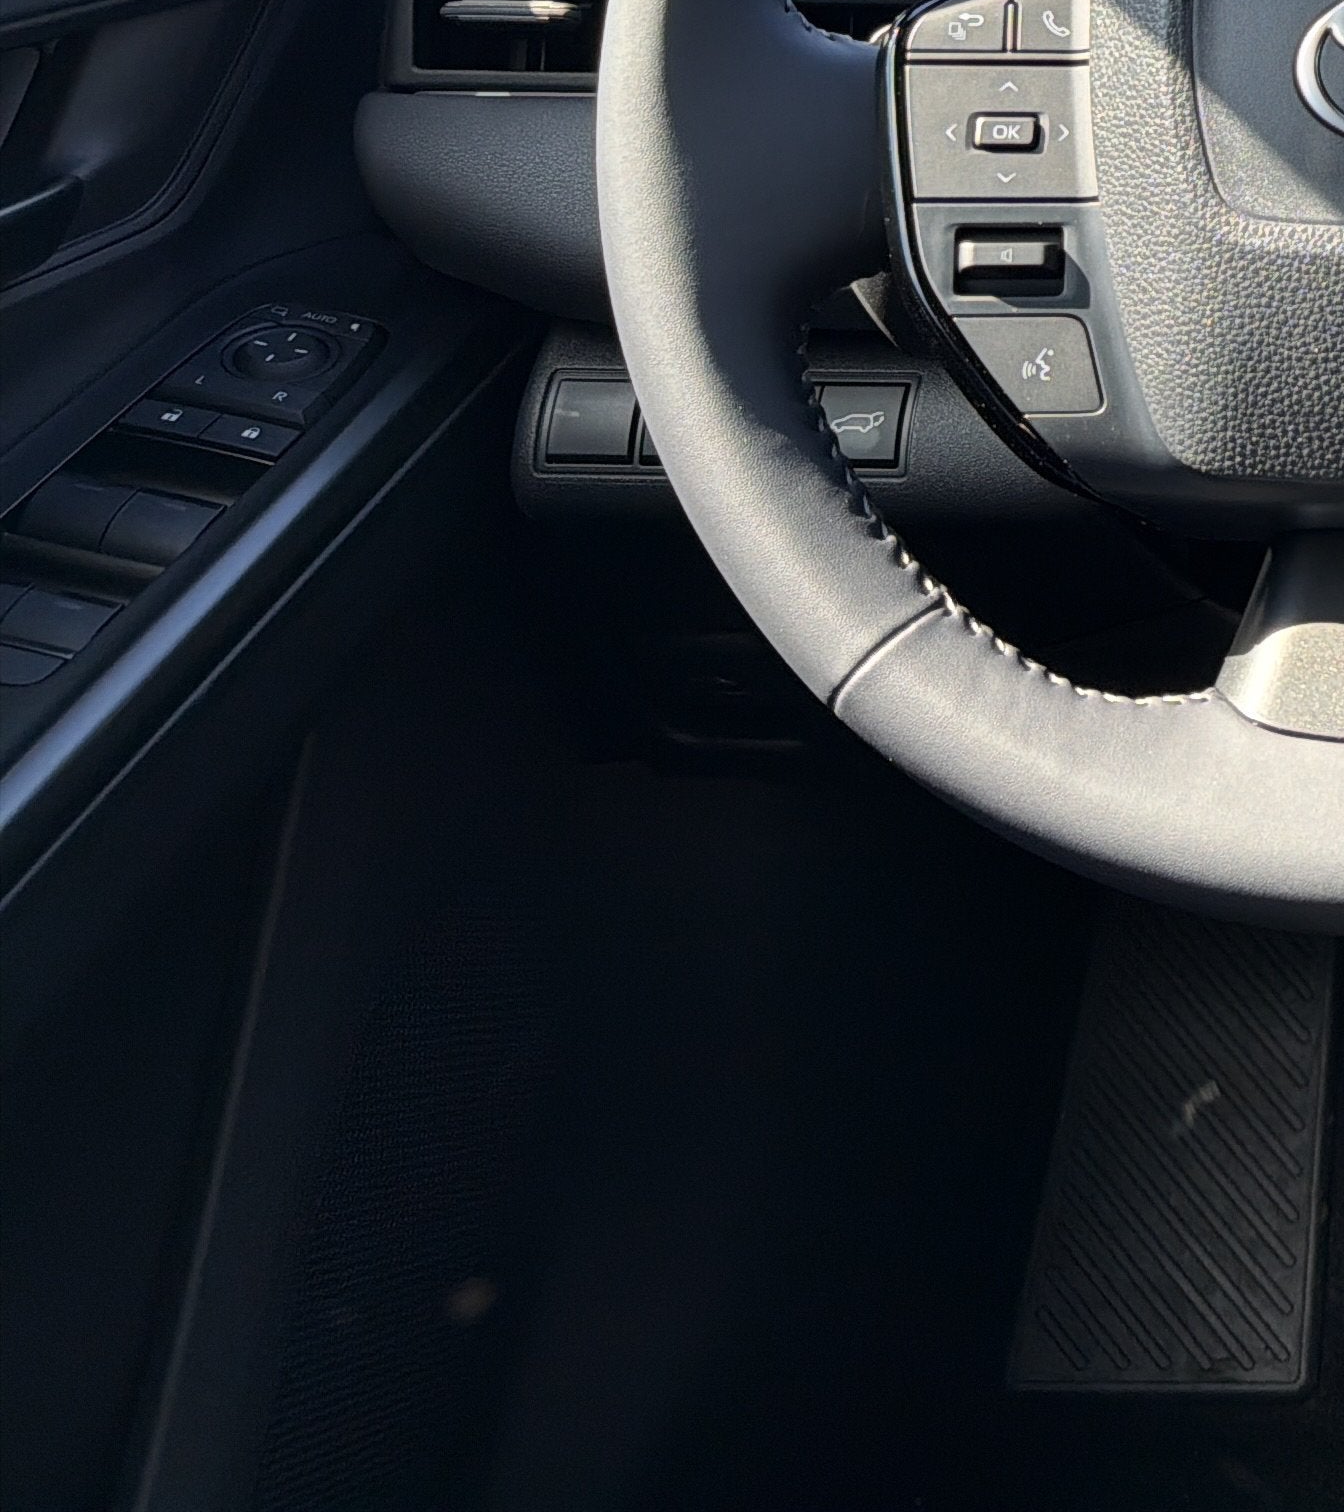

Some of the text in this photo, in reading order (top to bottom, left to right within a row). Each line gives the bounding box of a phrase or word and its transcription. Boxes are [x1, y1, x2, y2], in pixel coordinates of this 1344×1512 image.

[993, 124, 1021, 139] OK
[303, 312, 337, 323] AUTO
[272, 391, 288, 401] R
